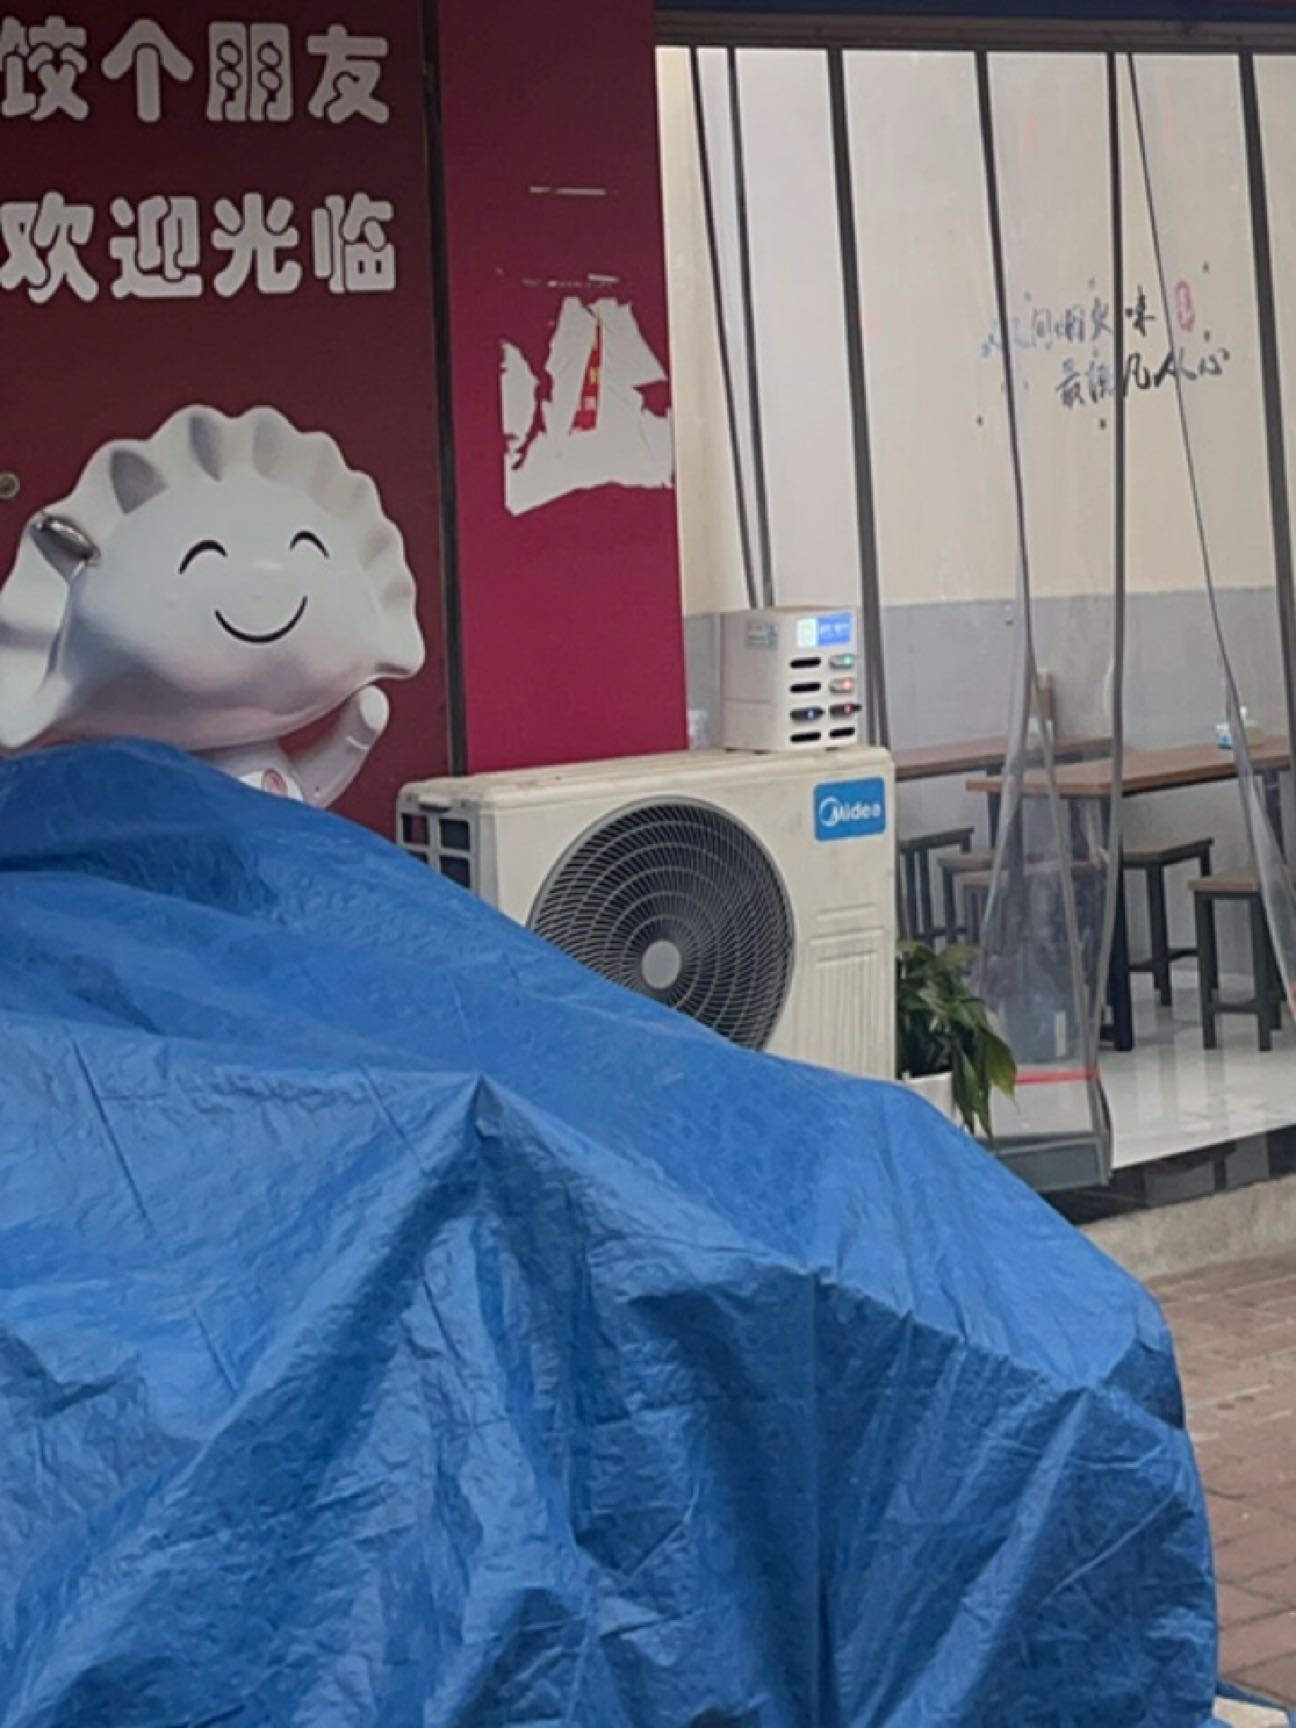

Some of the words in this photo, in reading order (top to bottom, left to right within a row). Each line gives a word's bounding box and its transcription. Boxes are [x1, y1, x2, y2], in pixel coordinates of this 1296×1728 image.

[0, 15, 390, 124] 饺个朋友
[0, 191, 397, 304] 欢迎光临
[819, 796, 881, 827] Midea
